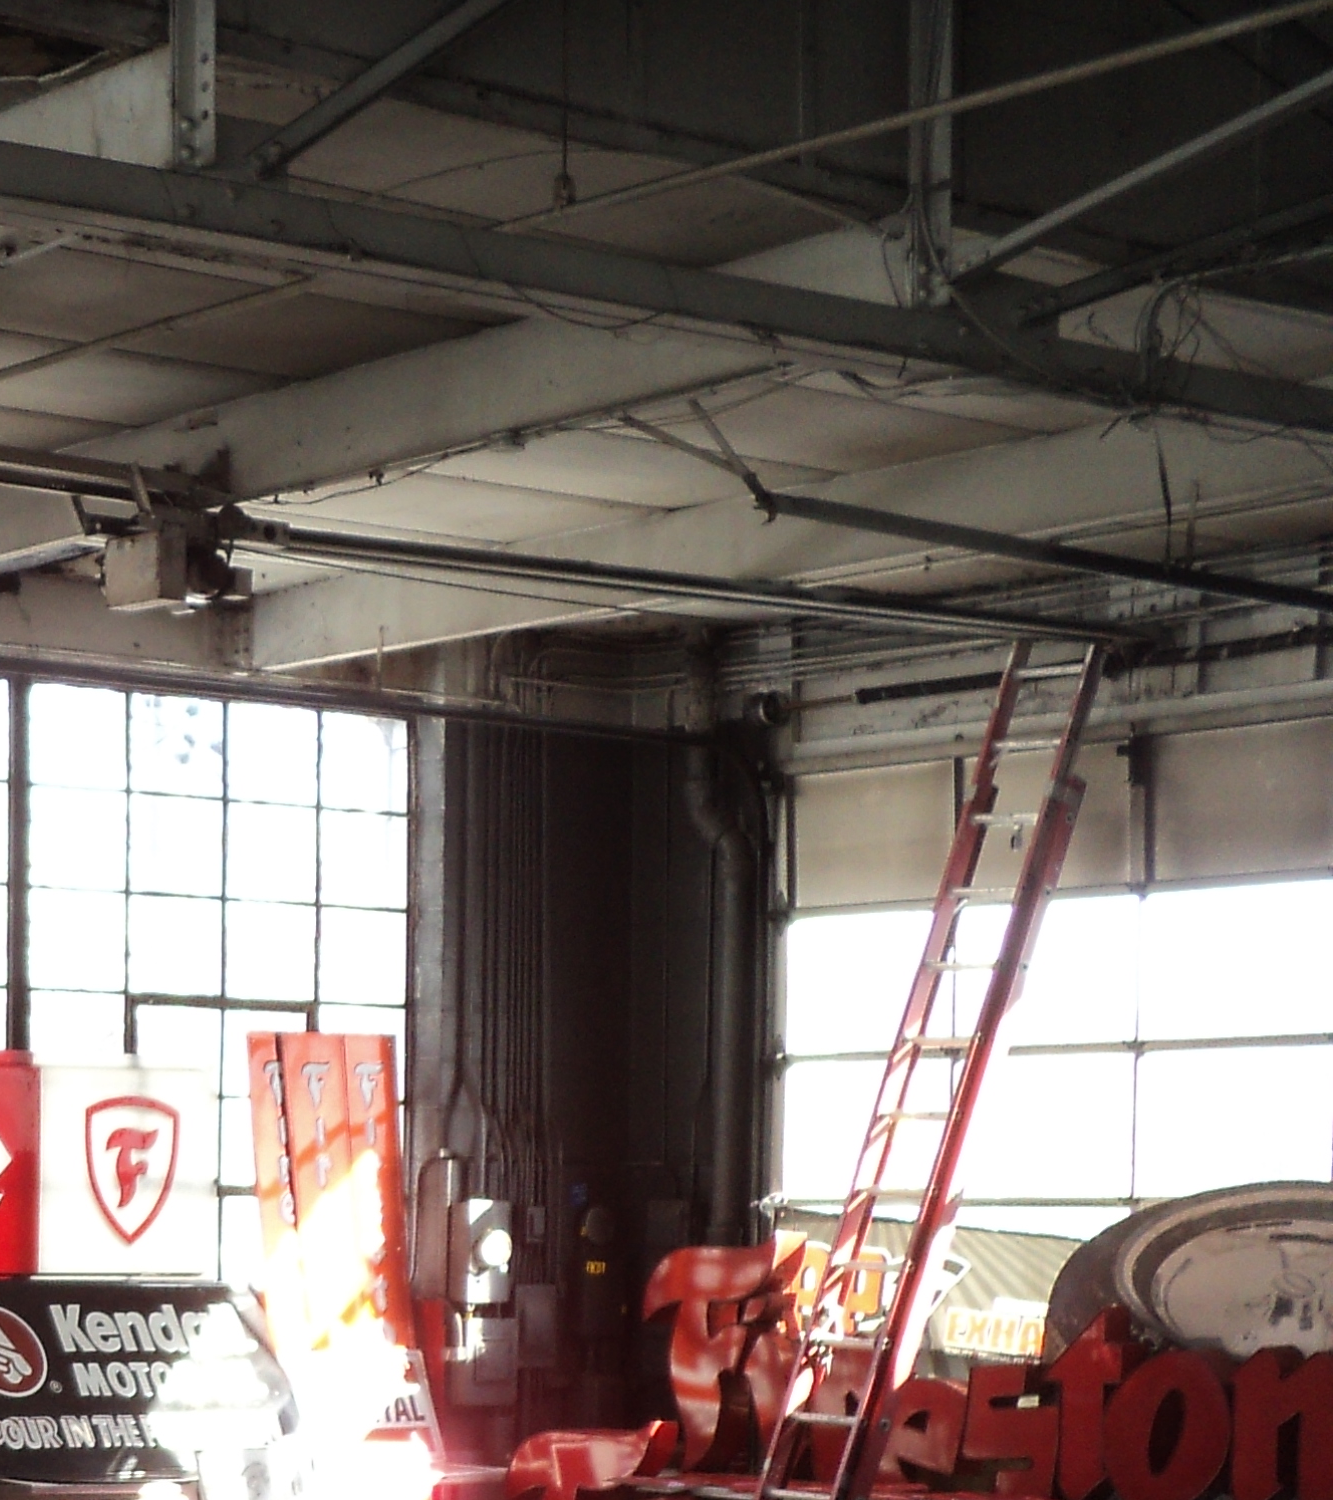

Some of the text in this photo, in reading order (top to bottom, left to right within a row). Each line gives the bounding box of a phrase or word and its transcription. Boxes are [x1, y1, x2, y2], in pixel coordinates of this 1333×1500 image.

[49, 1303, 210, 1354] Kenda
[946, 1312, 1043, 1356] EXHA
[73, 1361, 171, 1398] MOTO
[61, 1416, 97, 1449] IN
[92, 1415, 141, 1448] THE
